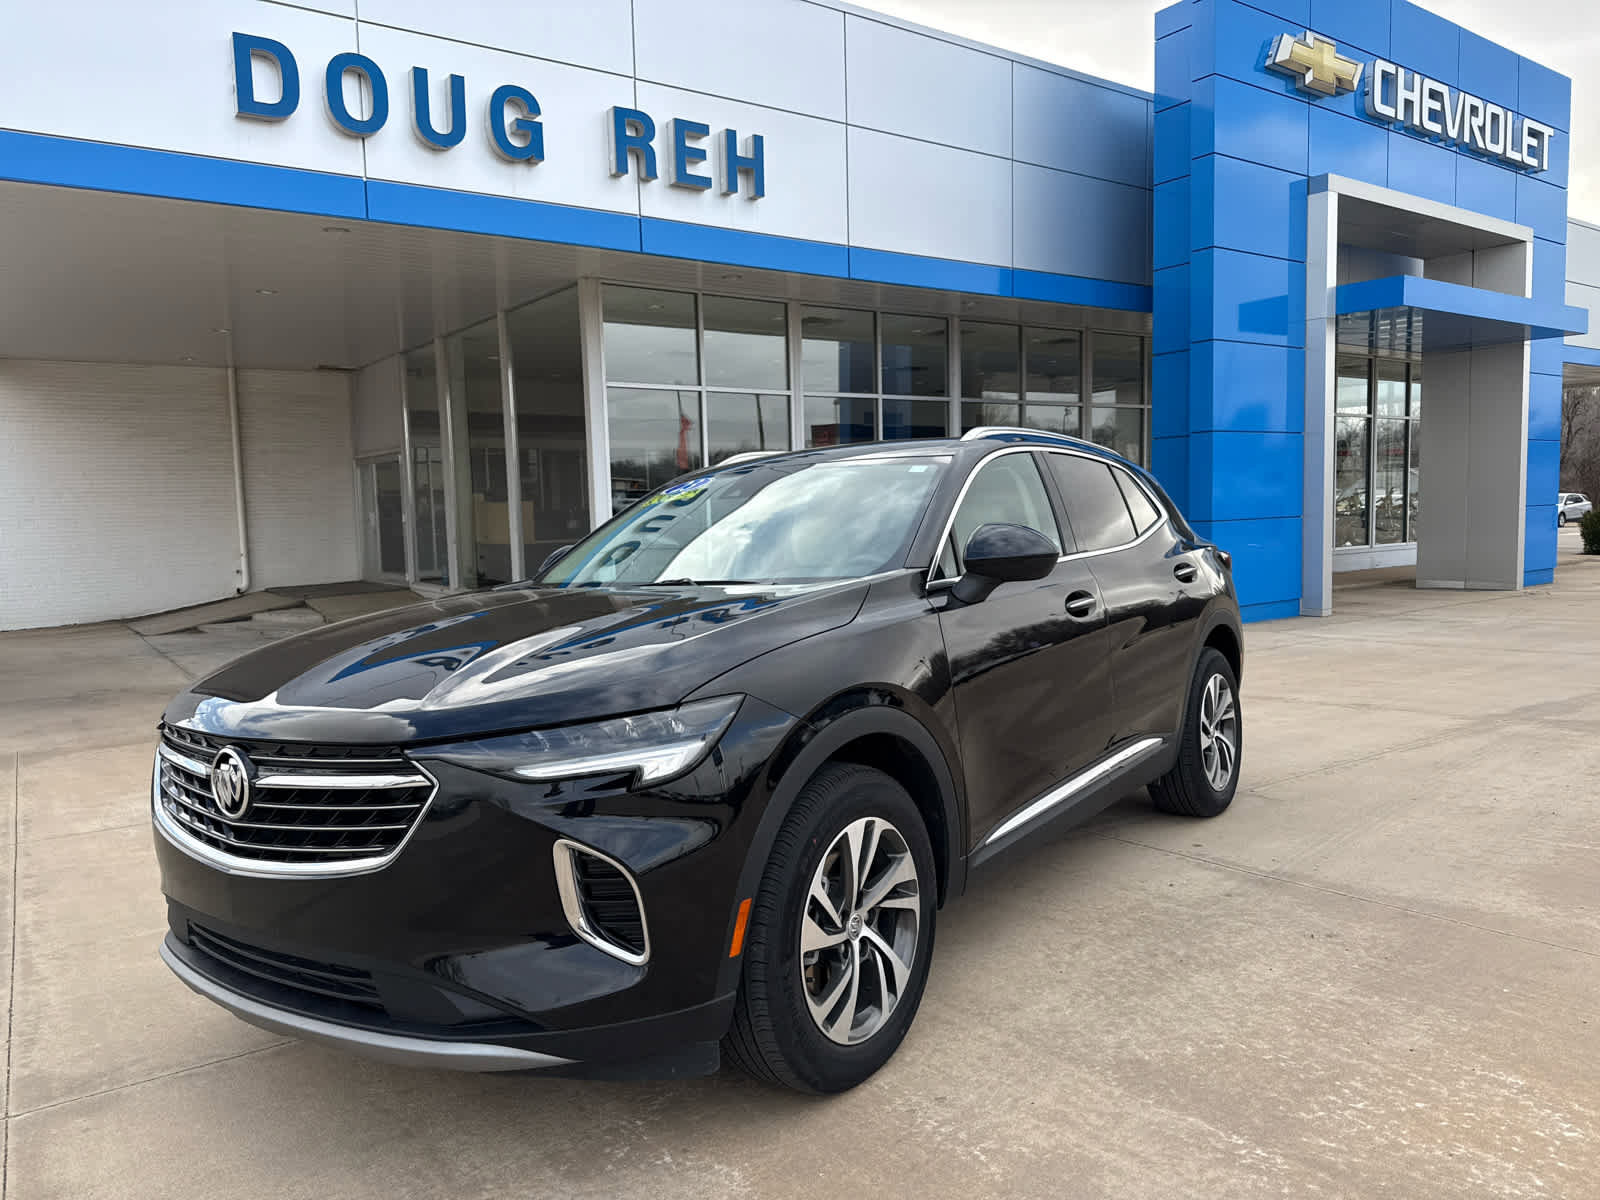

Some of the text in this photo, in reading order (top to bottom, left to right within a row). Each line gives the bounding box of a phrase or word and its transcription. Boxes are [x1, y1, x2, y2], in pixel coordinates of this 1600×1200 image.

[232, 32, 765, 199] DOUG REH
[1369, 59, 1554, 171] CHEVROLET
